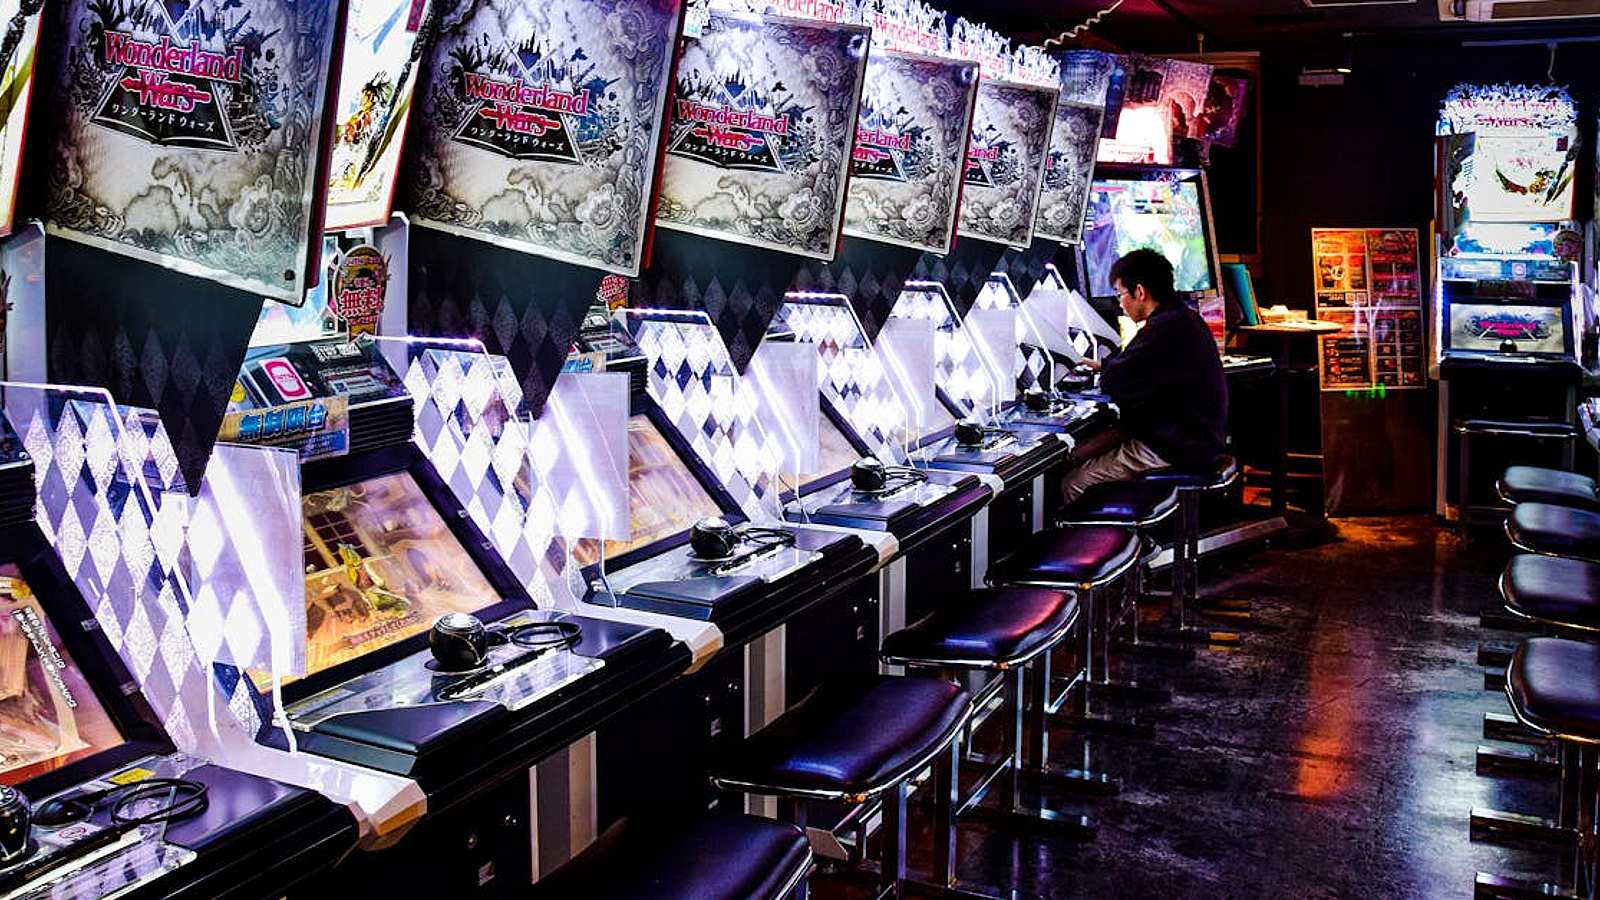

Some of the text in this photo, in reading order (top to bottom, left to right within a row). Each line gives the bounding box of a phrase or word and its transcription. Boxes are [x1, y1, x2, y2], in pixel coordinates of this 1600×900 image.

[104, 30, 245, 83] Wonderland
[130, 69, 204, 112] Wars
[463, 72, 589, 117] Wonderland
[487, 102, 553, 137] Wars
[677, 99, 789, 136] Wonderland
[699, 122, 758, 151] Wars
